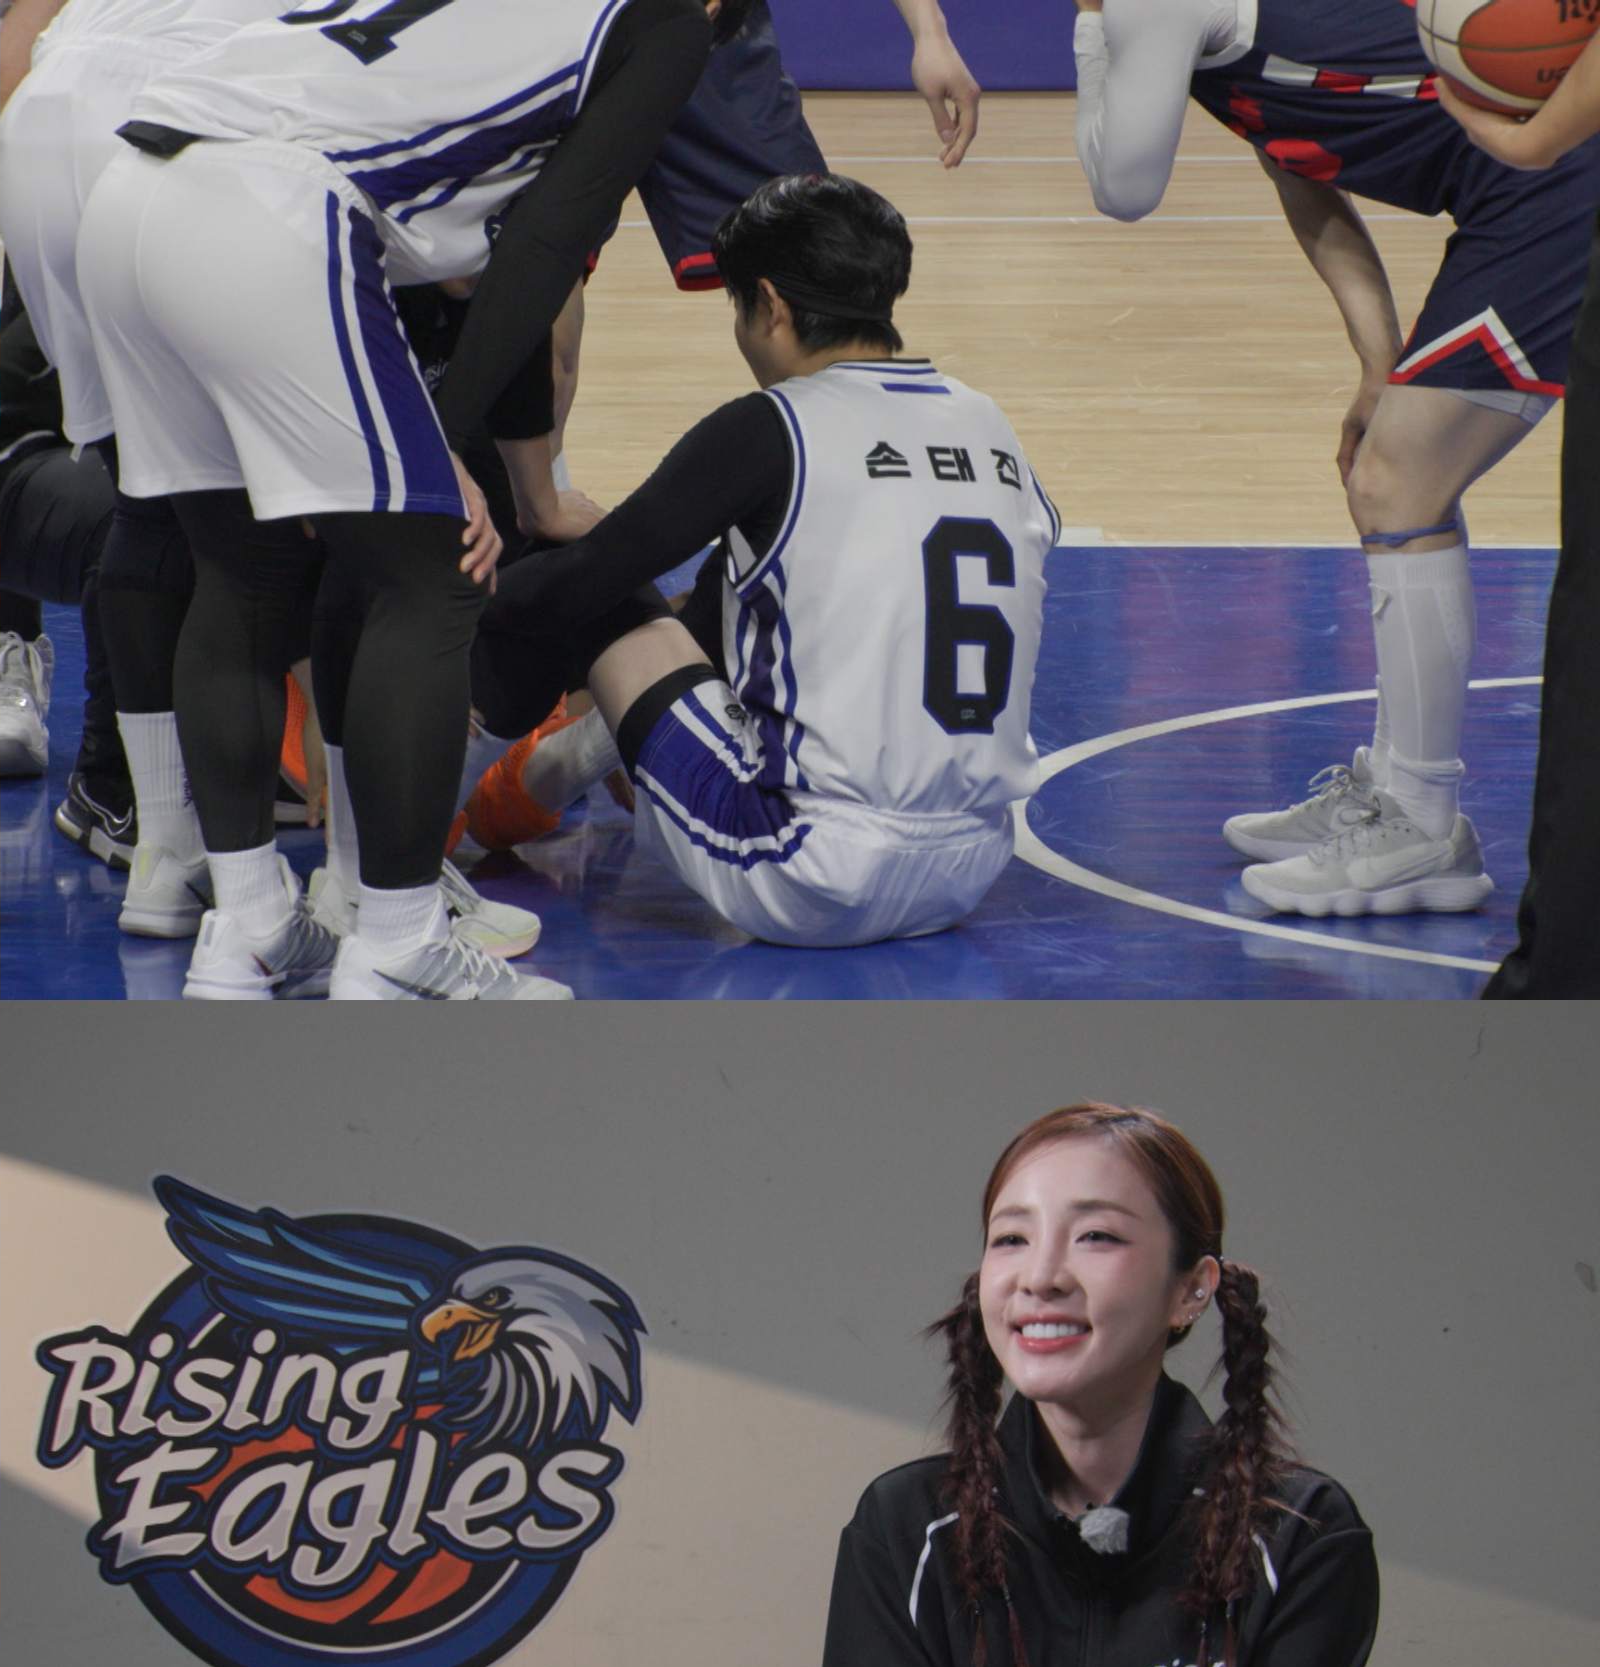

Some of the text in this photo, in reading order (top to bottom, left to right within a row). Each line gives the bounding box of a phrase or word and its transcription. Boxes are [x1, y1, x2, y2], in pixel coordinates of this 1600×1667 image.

[921, 515, 1016, 735] 6
[43, 1327, 410, 1451] Rising
[101, 1430, 612, 1587] Eagles
